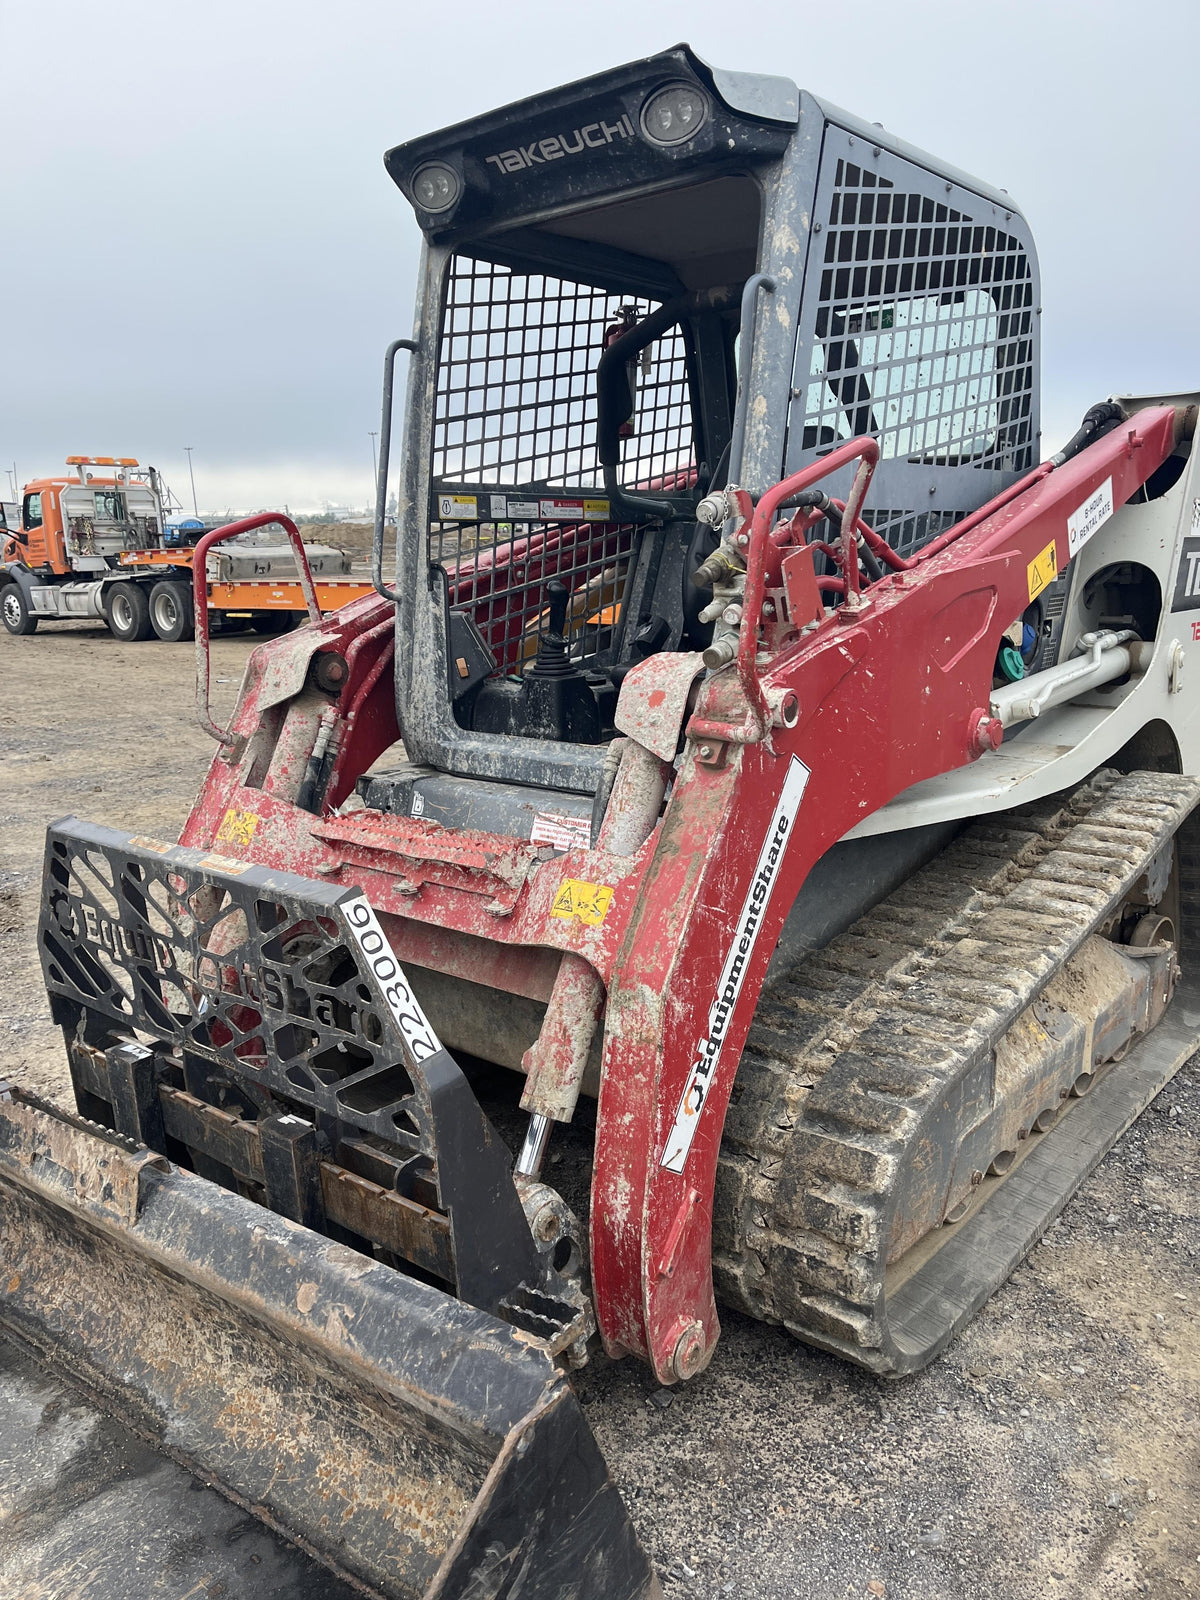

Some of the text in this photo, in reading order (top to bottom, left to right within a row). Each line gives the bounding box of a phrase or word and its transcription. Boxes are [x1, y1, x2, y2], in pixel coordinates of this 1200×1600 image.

[1079, 501, 1111, 540] RENTAL RATE
[347, 903, 437, 1061] 223006
[694, 814, 789, 1079] EquipmentShare
